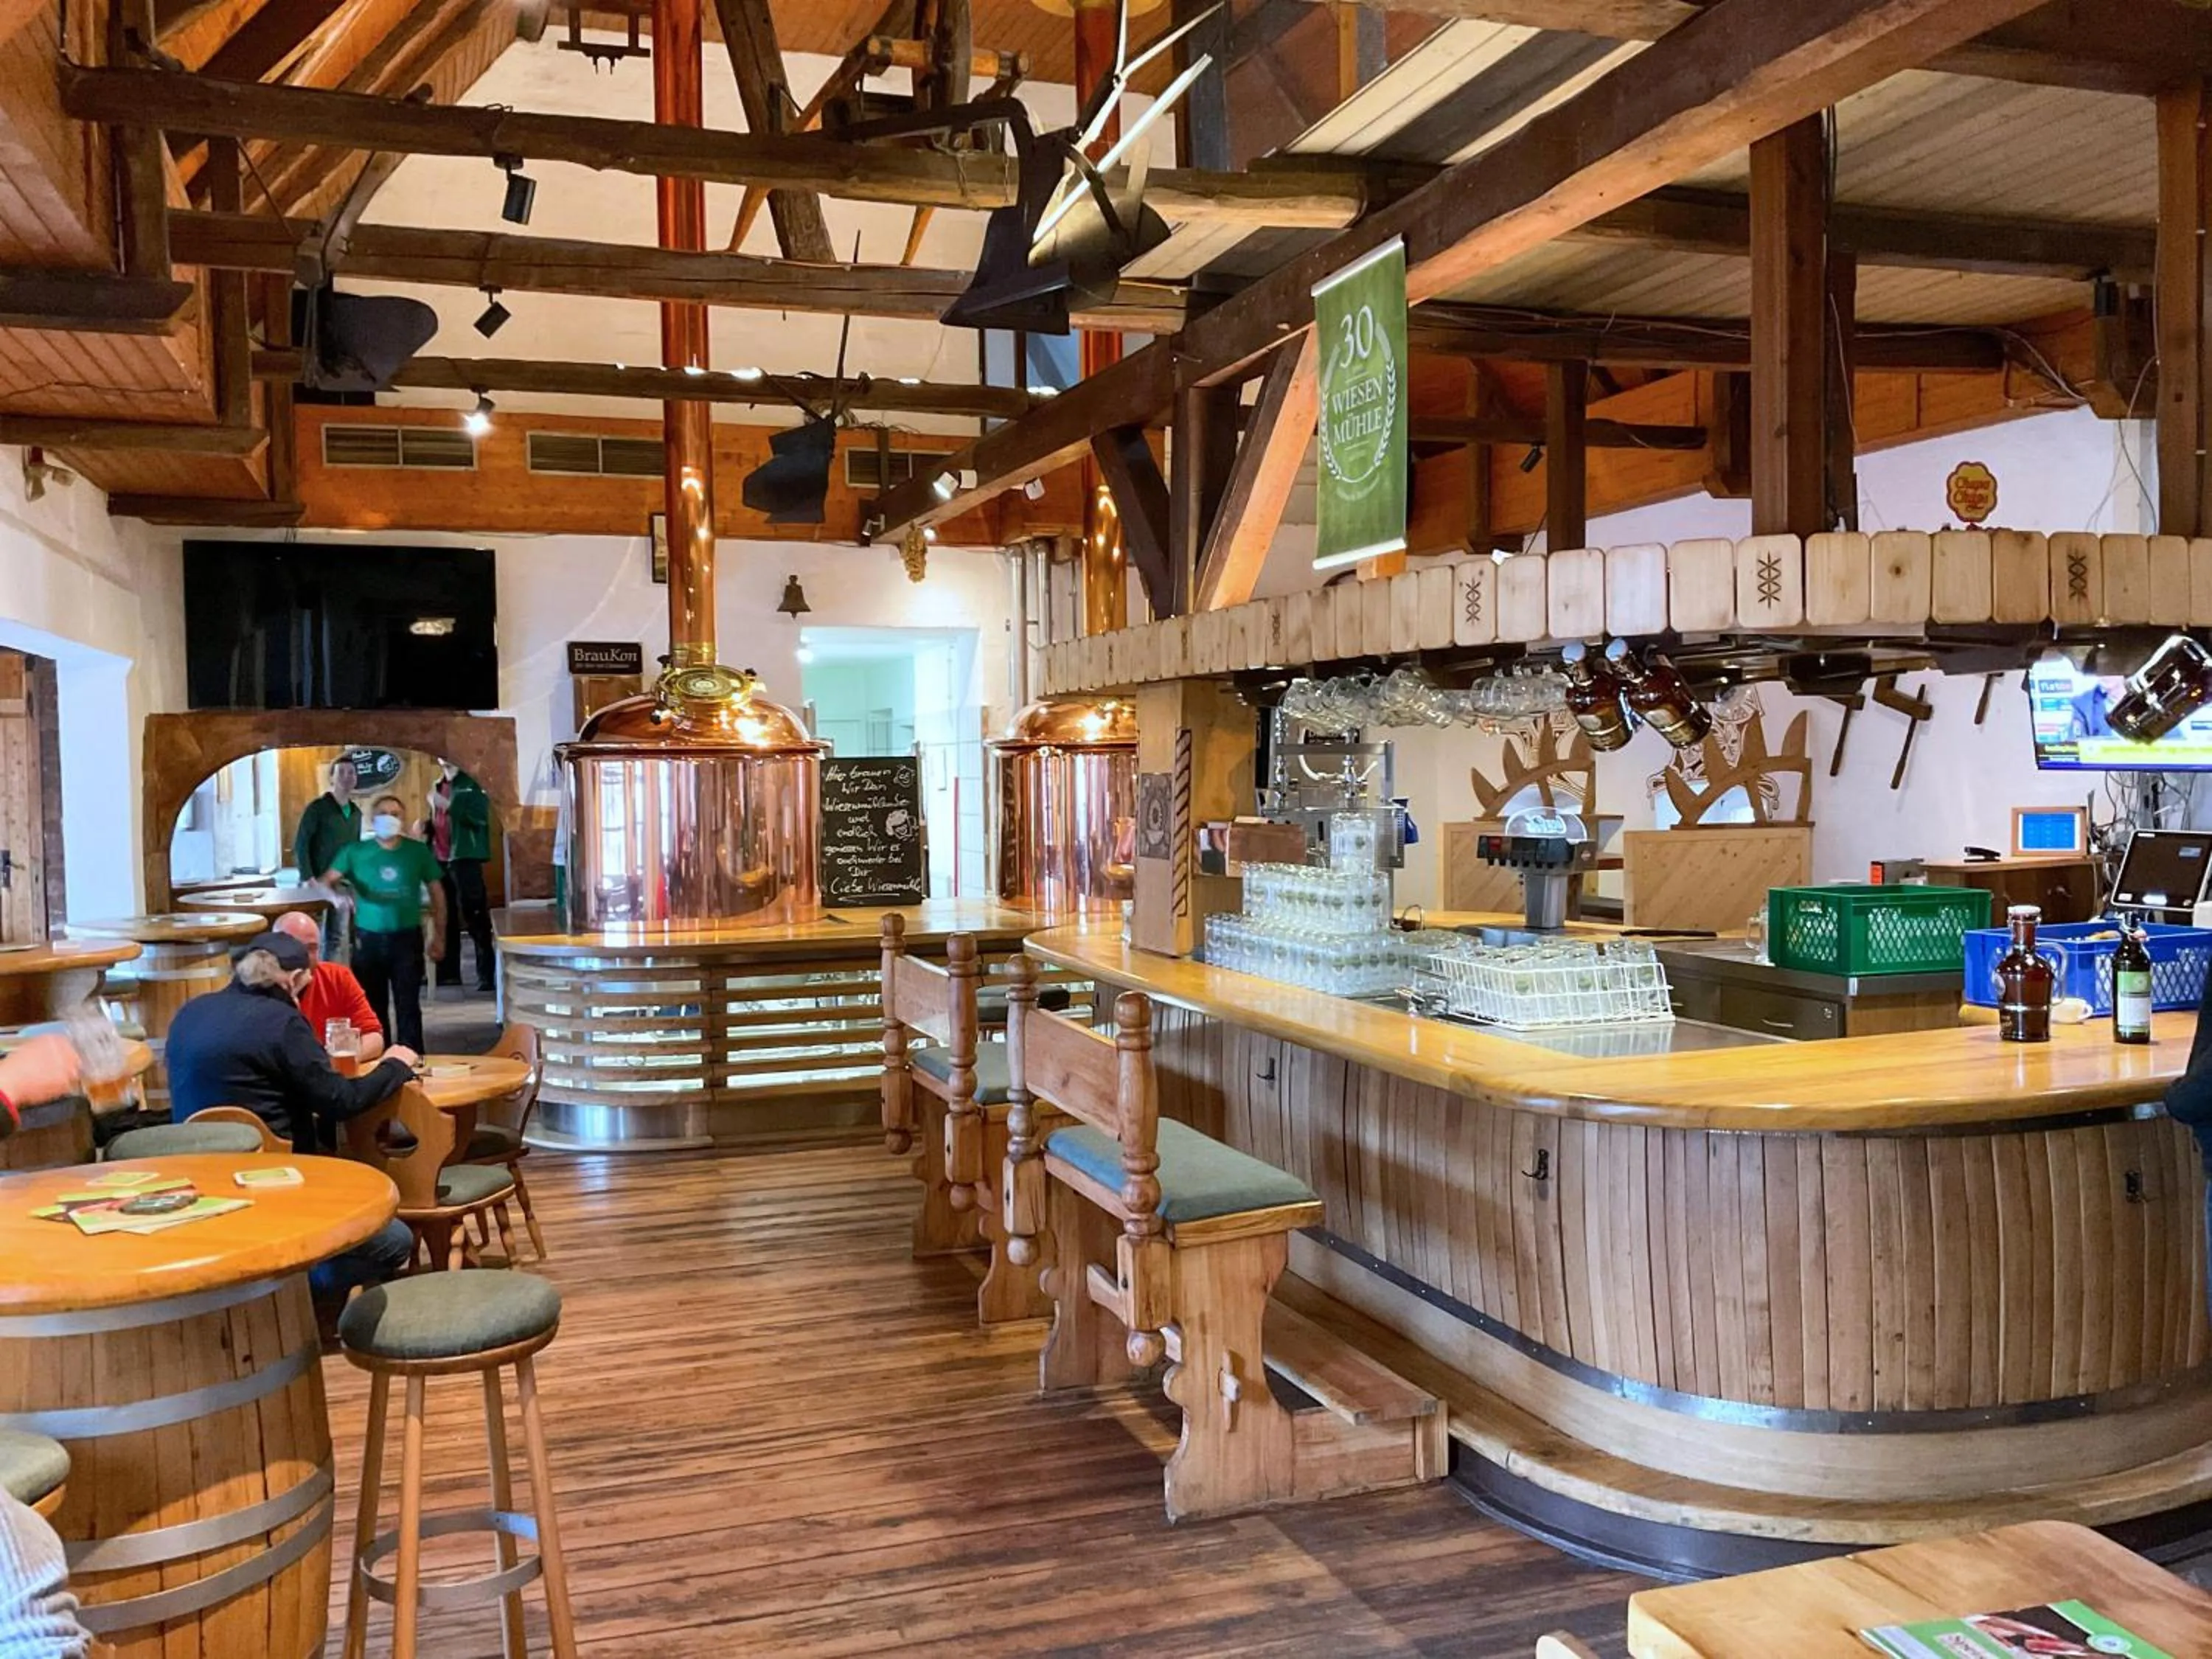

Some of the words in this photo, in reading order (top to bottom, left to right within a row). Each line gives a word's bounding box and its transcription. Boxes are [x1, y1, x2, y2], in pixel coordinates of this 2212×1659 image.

[1340, 305, 1374, 368] 30
[1332, 374, 1382, 414] WIESEN
[1333, 406, 1382, 445] MÜHLE
[574, 648, 637, 661] BrauKon
